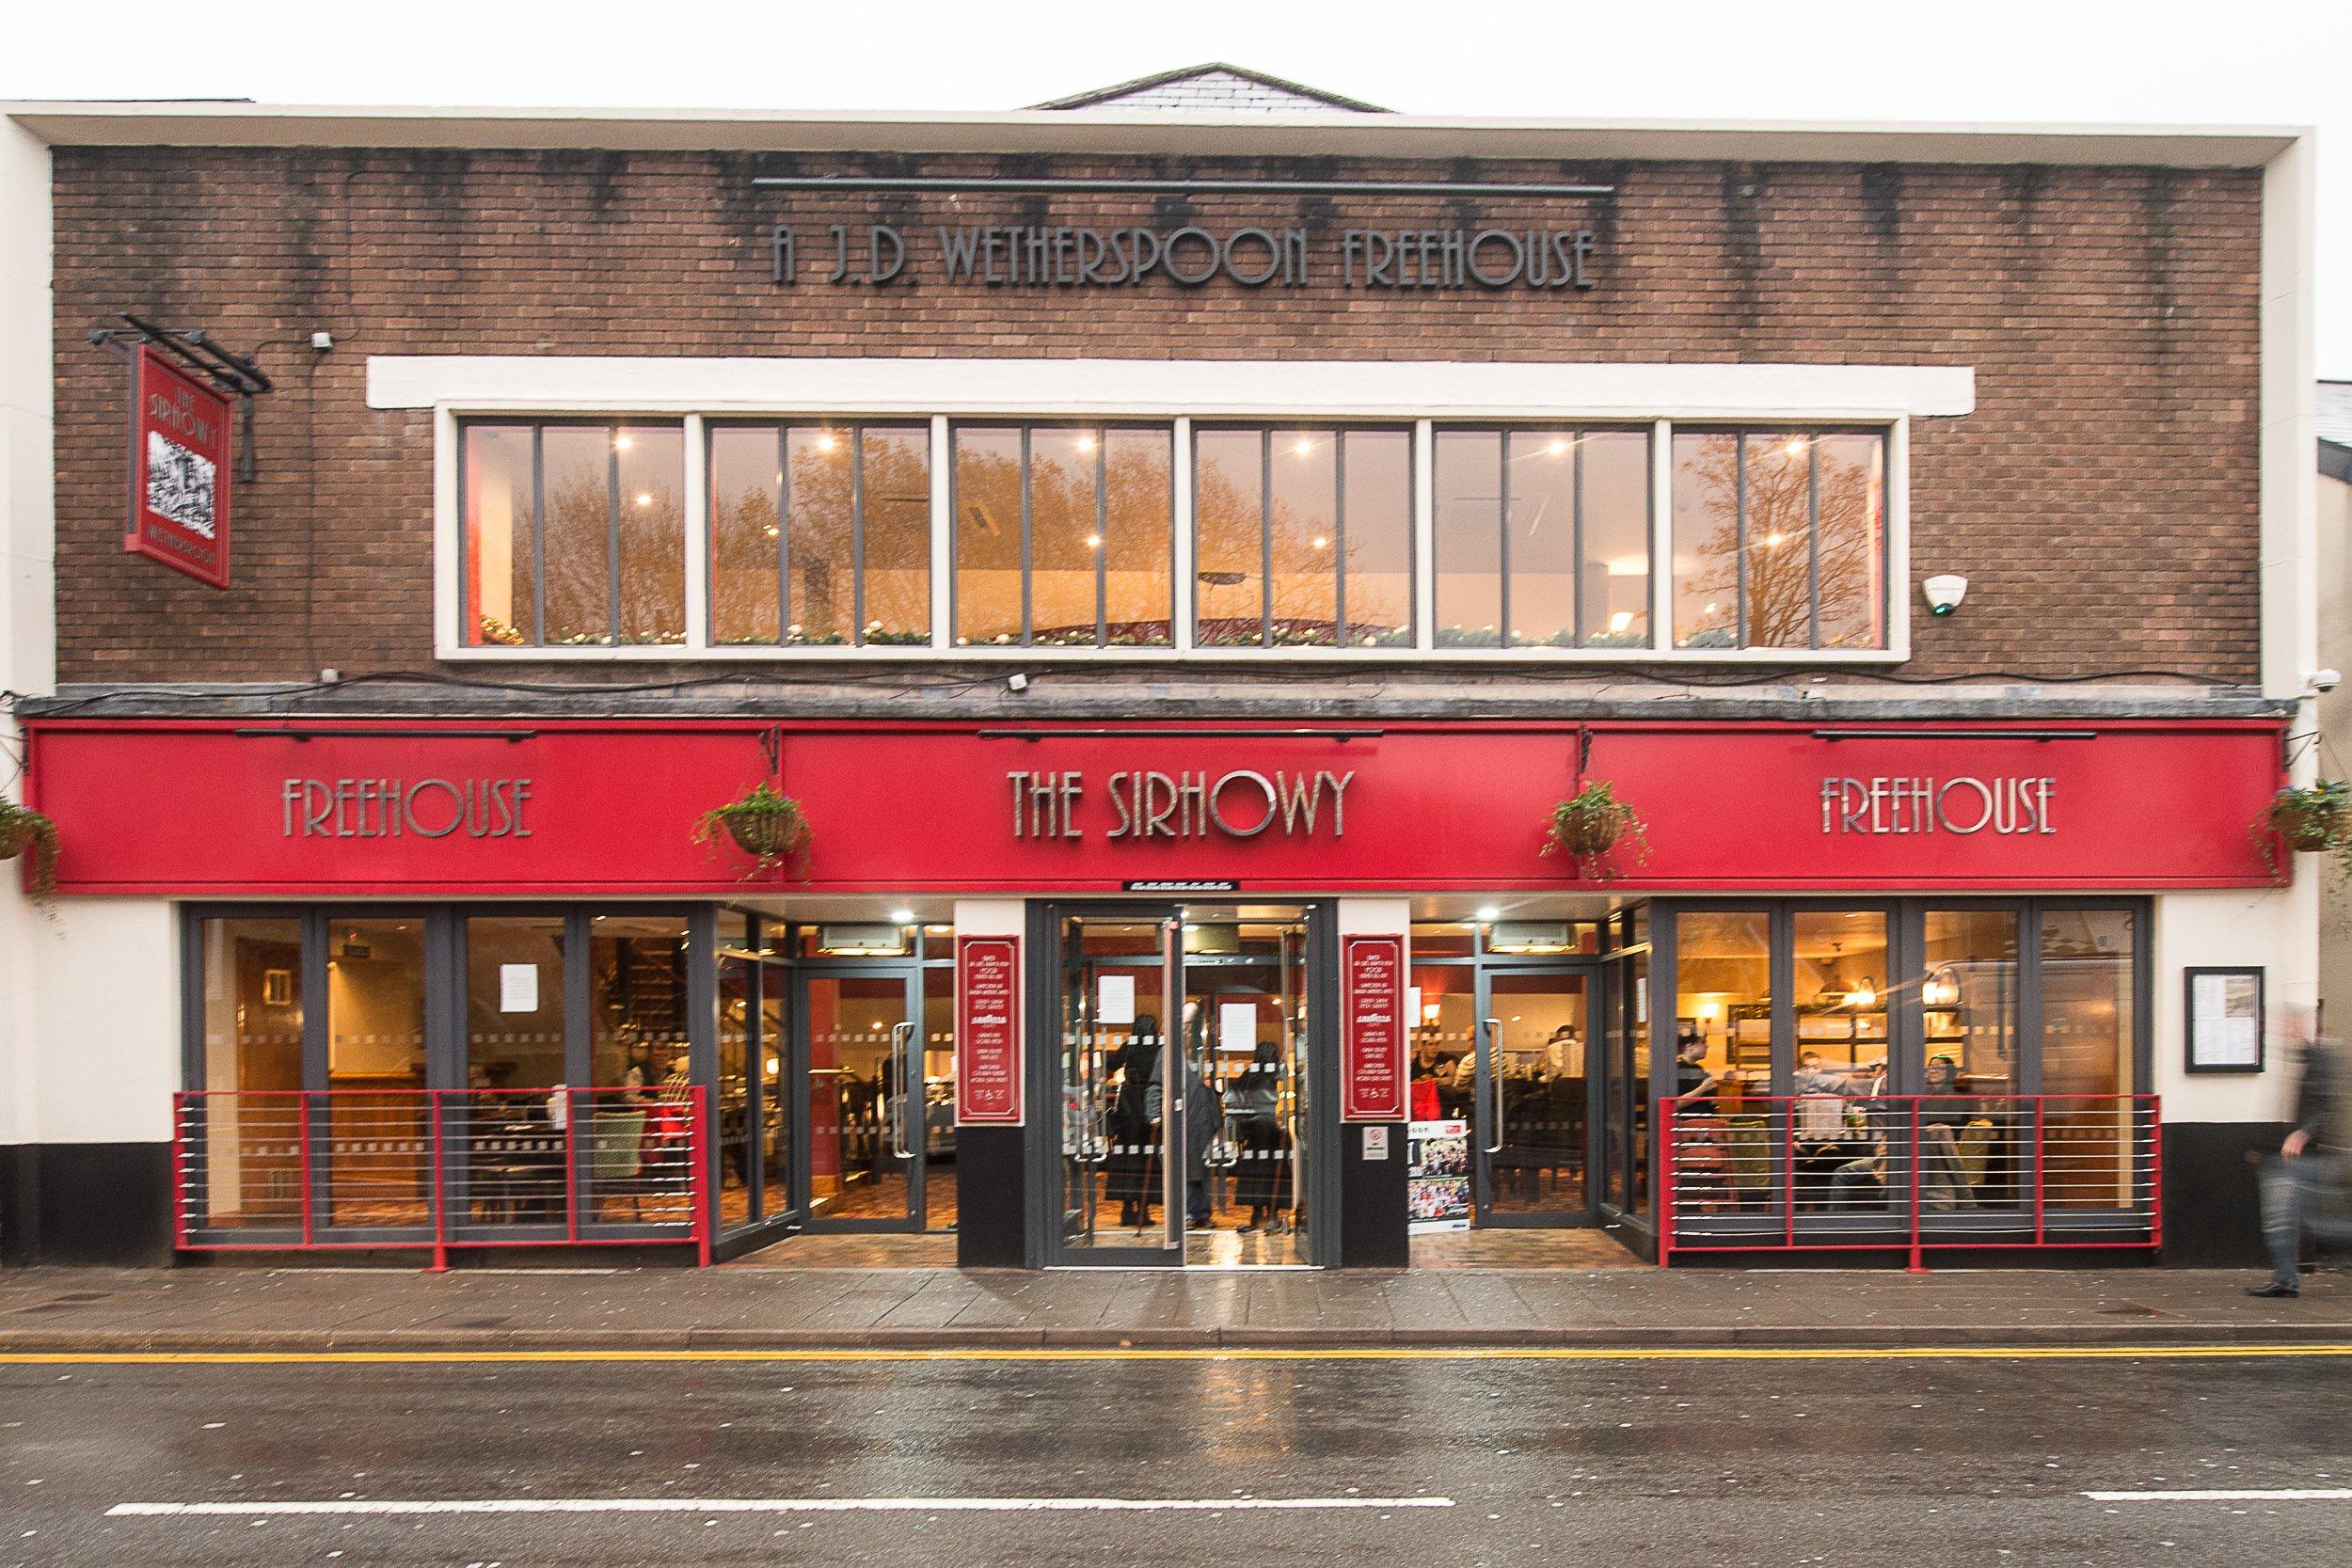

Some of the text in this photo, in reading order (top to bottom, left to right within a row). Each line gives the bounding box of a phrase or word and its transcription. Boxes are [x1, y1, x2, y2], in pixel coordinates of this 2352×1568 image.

[771, 225, 1595, 287] A J.D. WETHERSPOON FREEHOUSE
[149, 393, 217, 449] SIRHOWY
[282, 778, 532, 837] FREEHOUSE
[1007, 769, 1356, 837] THE SIRHOWY
[1820, 777, 2058, 834] FREEHOUSE
